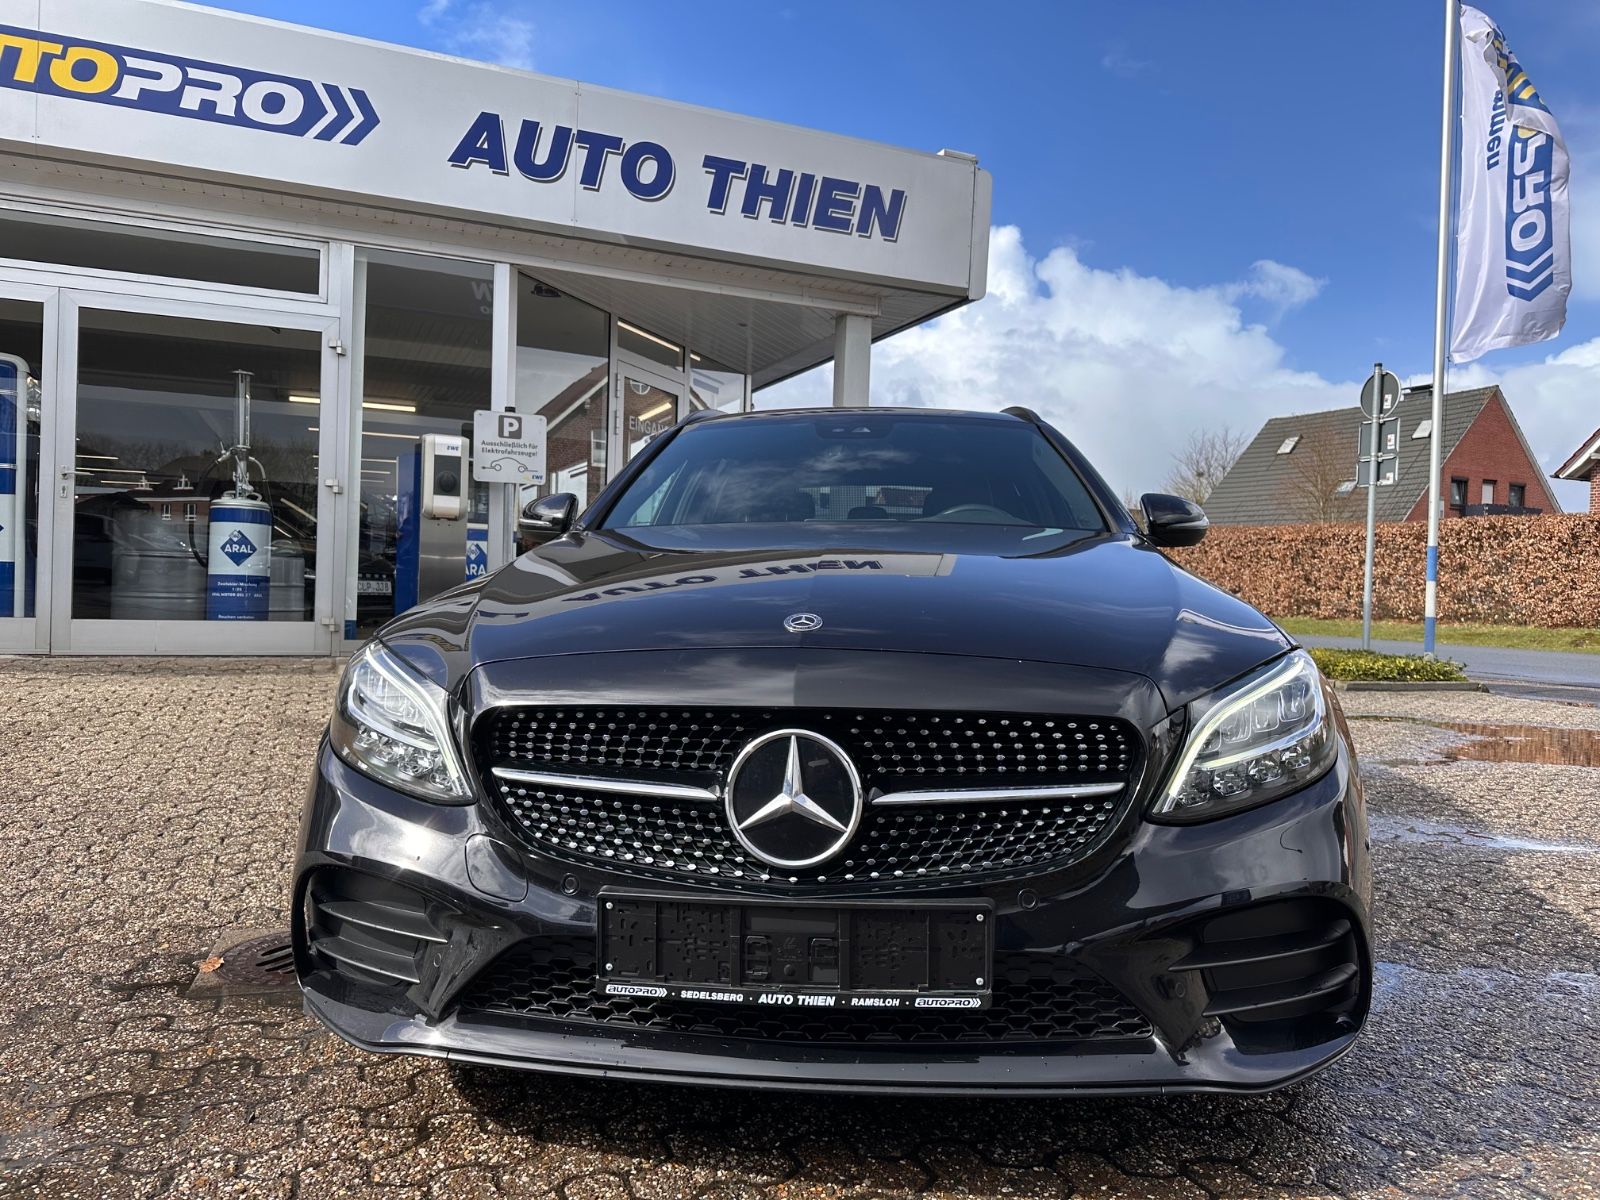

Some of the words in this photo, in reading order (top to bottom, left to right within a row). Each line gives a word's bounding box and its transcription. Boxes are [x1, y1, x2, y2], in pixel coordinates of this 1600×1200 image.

[0, 33, 305, 126] TOPRO
[448, 111, 675, 201] AUTO
[702, 155, 907, 243] THIEN
[503, 417, 520, 437] P
[224, 544, 253, 554] ARAL
[680, 990, 744, 1002] SEDELSBERG
[758, 993, 793, 1005] AUTO
[797, 995, 836, 1006] THIEN
[851, 998, 900, 1006] RAMSLOH
